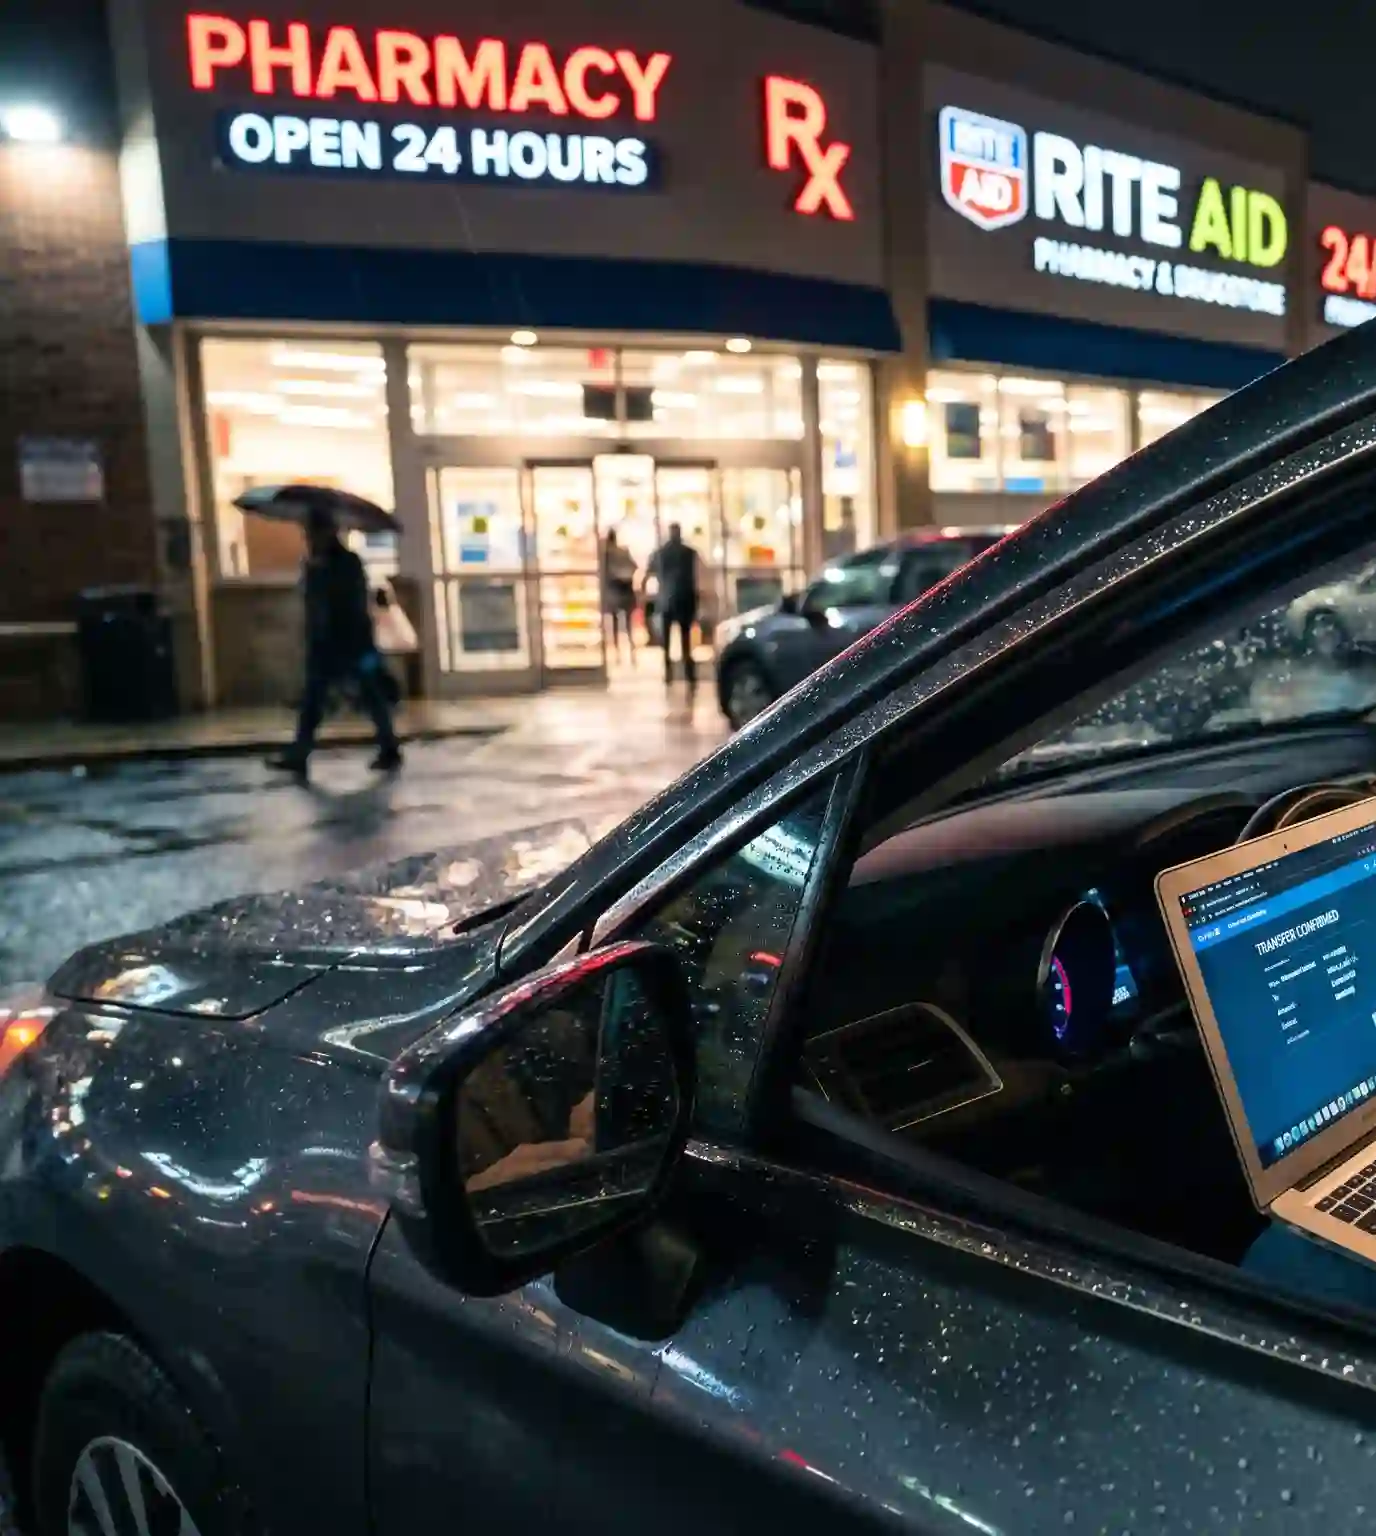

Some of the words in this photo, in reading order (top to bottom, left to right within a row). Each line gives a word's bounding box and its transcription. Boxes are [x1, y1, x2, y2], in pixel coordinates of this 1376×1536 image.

[187, 14, 671, 120] PHARMACY
[229, 112, 383, 170] OPEN
[392, 122, 462, 174] 24
[470, 131, 648, 186] HOURS
[1033, 132, 1182, 248] RITE
[1190, 178, 1287, 267] AID
[1255, 930, 1296, 955] TRANSFER
